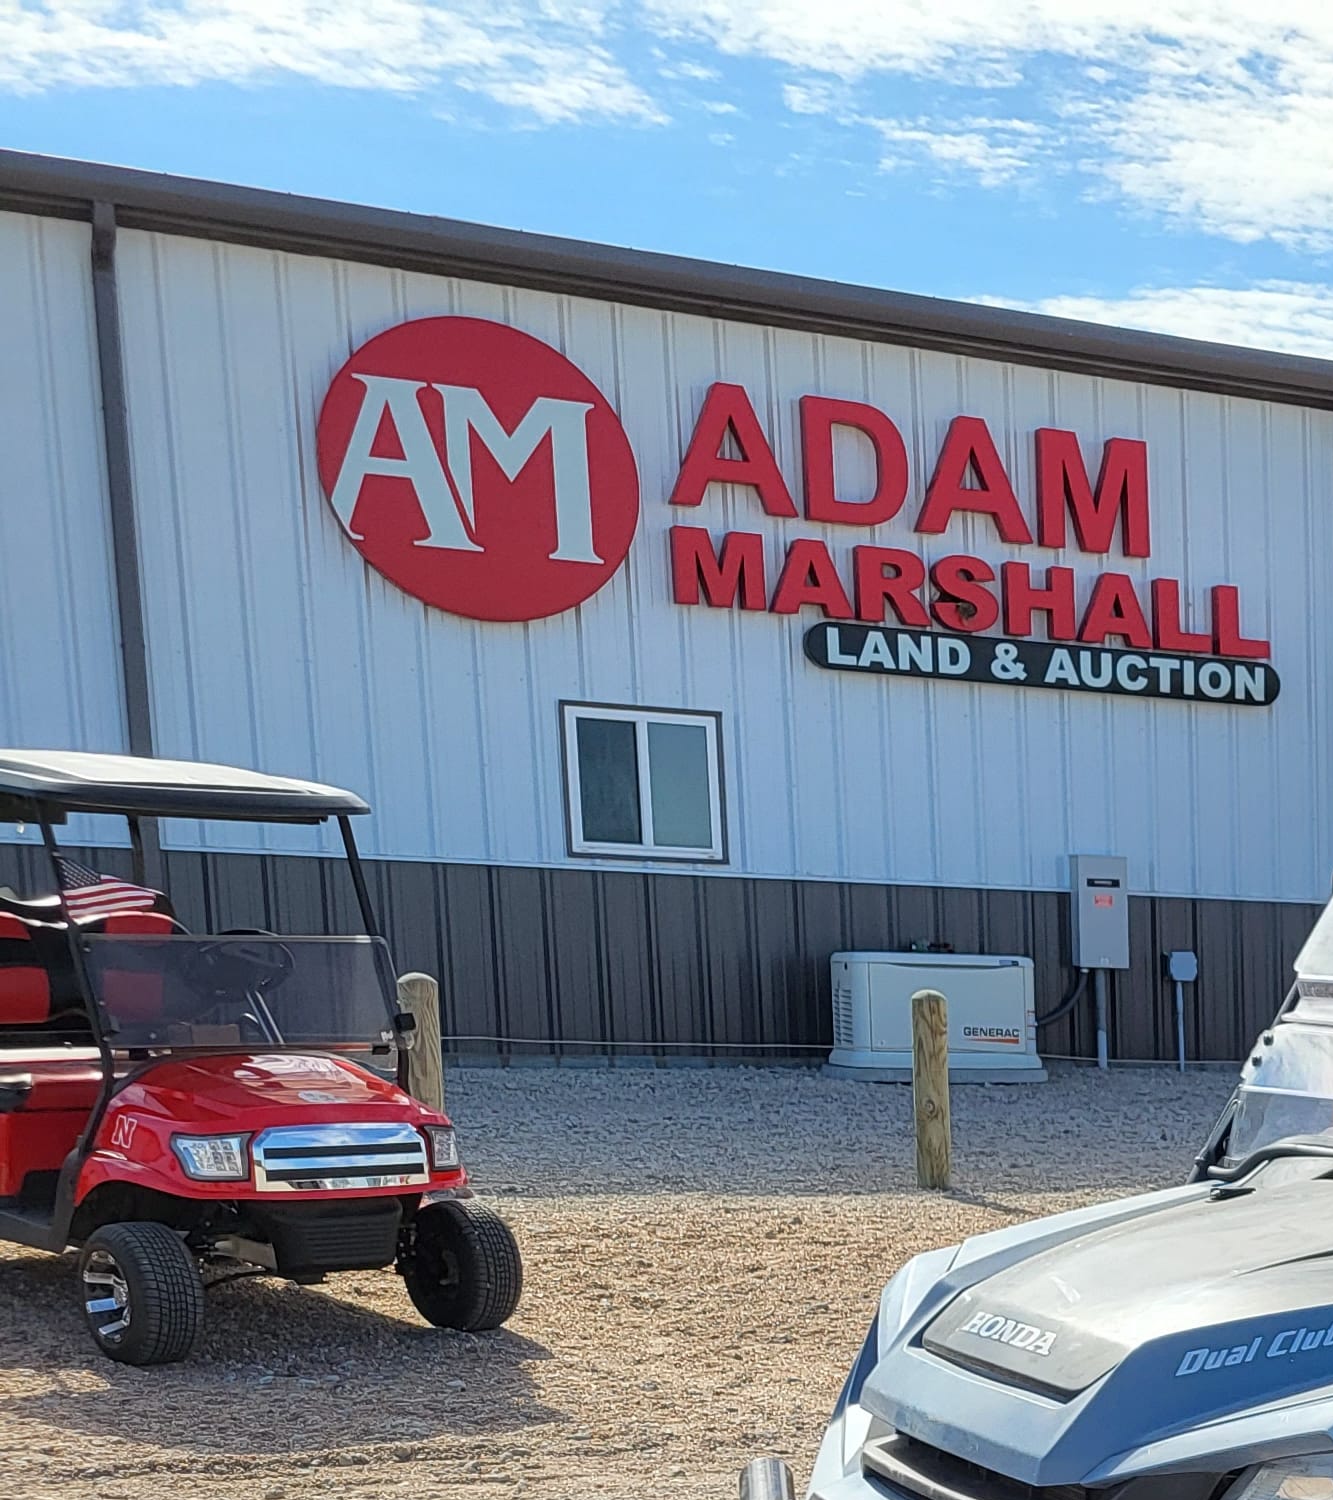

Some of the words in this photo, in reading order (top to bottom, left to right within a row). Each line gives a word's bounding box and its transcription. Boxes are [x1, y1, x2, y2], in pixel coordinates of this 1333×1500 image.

[669, 381, 1152, 558] ADAM
[670, 526, 1271, 660] MARSHALL
[825, 626, 972, 677] LAND
[990, 645, 1027, 683] &
[1043, 647, 1268, 702] AUCTION
[963, 1026, 1020, 1038] GENERAC
[111, 1114, 137, 1149] N
[961, 1311, 1057, 1356] HONDA
[1175, 1336, 1264, 1377] Dual
